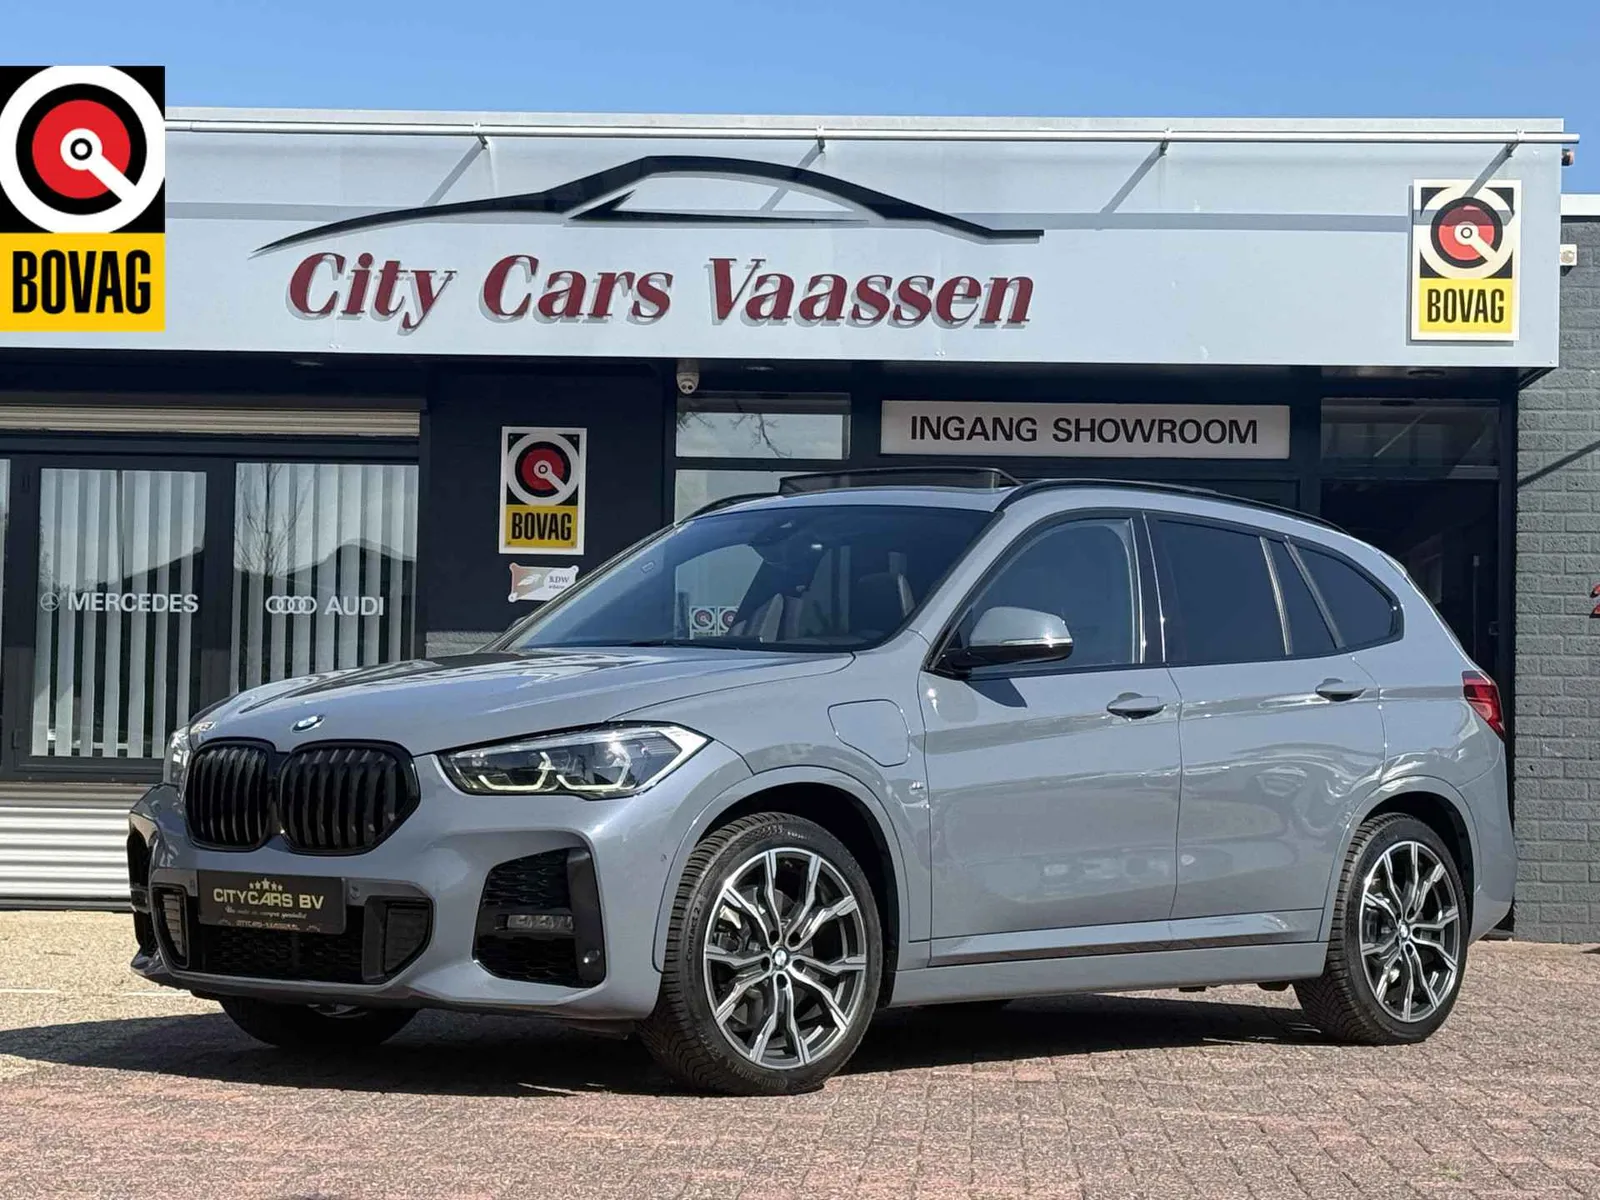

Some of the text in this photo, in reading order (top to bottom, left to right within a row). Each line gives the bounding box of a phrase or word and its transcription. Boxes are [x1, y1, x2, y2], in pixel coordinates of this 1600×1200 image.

[287, 251, 1035, 333] City Cars Vaassen
[1426, 288, 1505, 323] BOVAG
[910, 414, 1258, 444] INGANG SHOWROOM
[511, 512, 572, 541] BOVAG
[67, 592, 199, 613] MERCEDES
[324, 596, 384, 616] AUDI
[213, 888, 324, 909] CITYCARS BV
